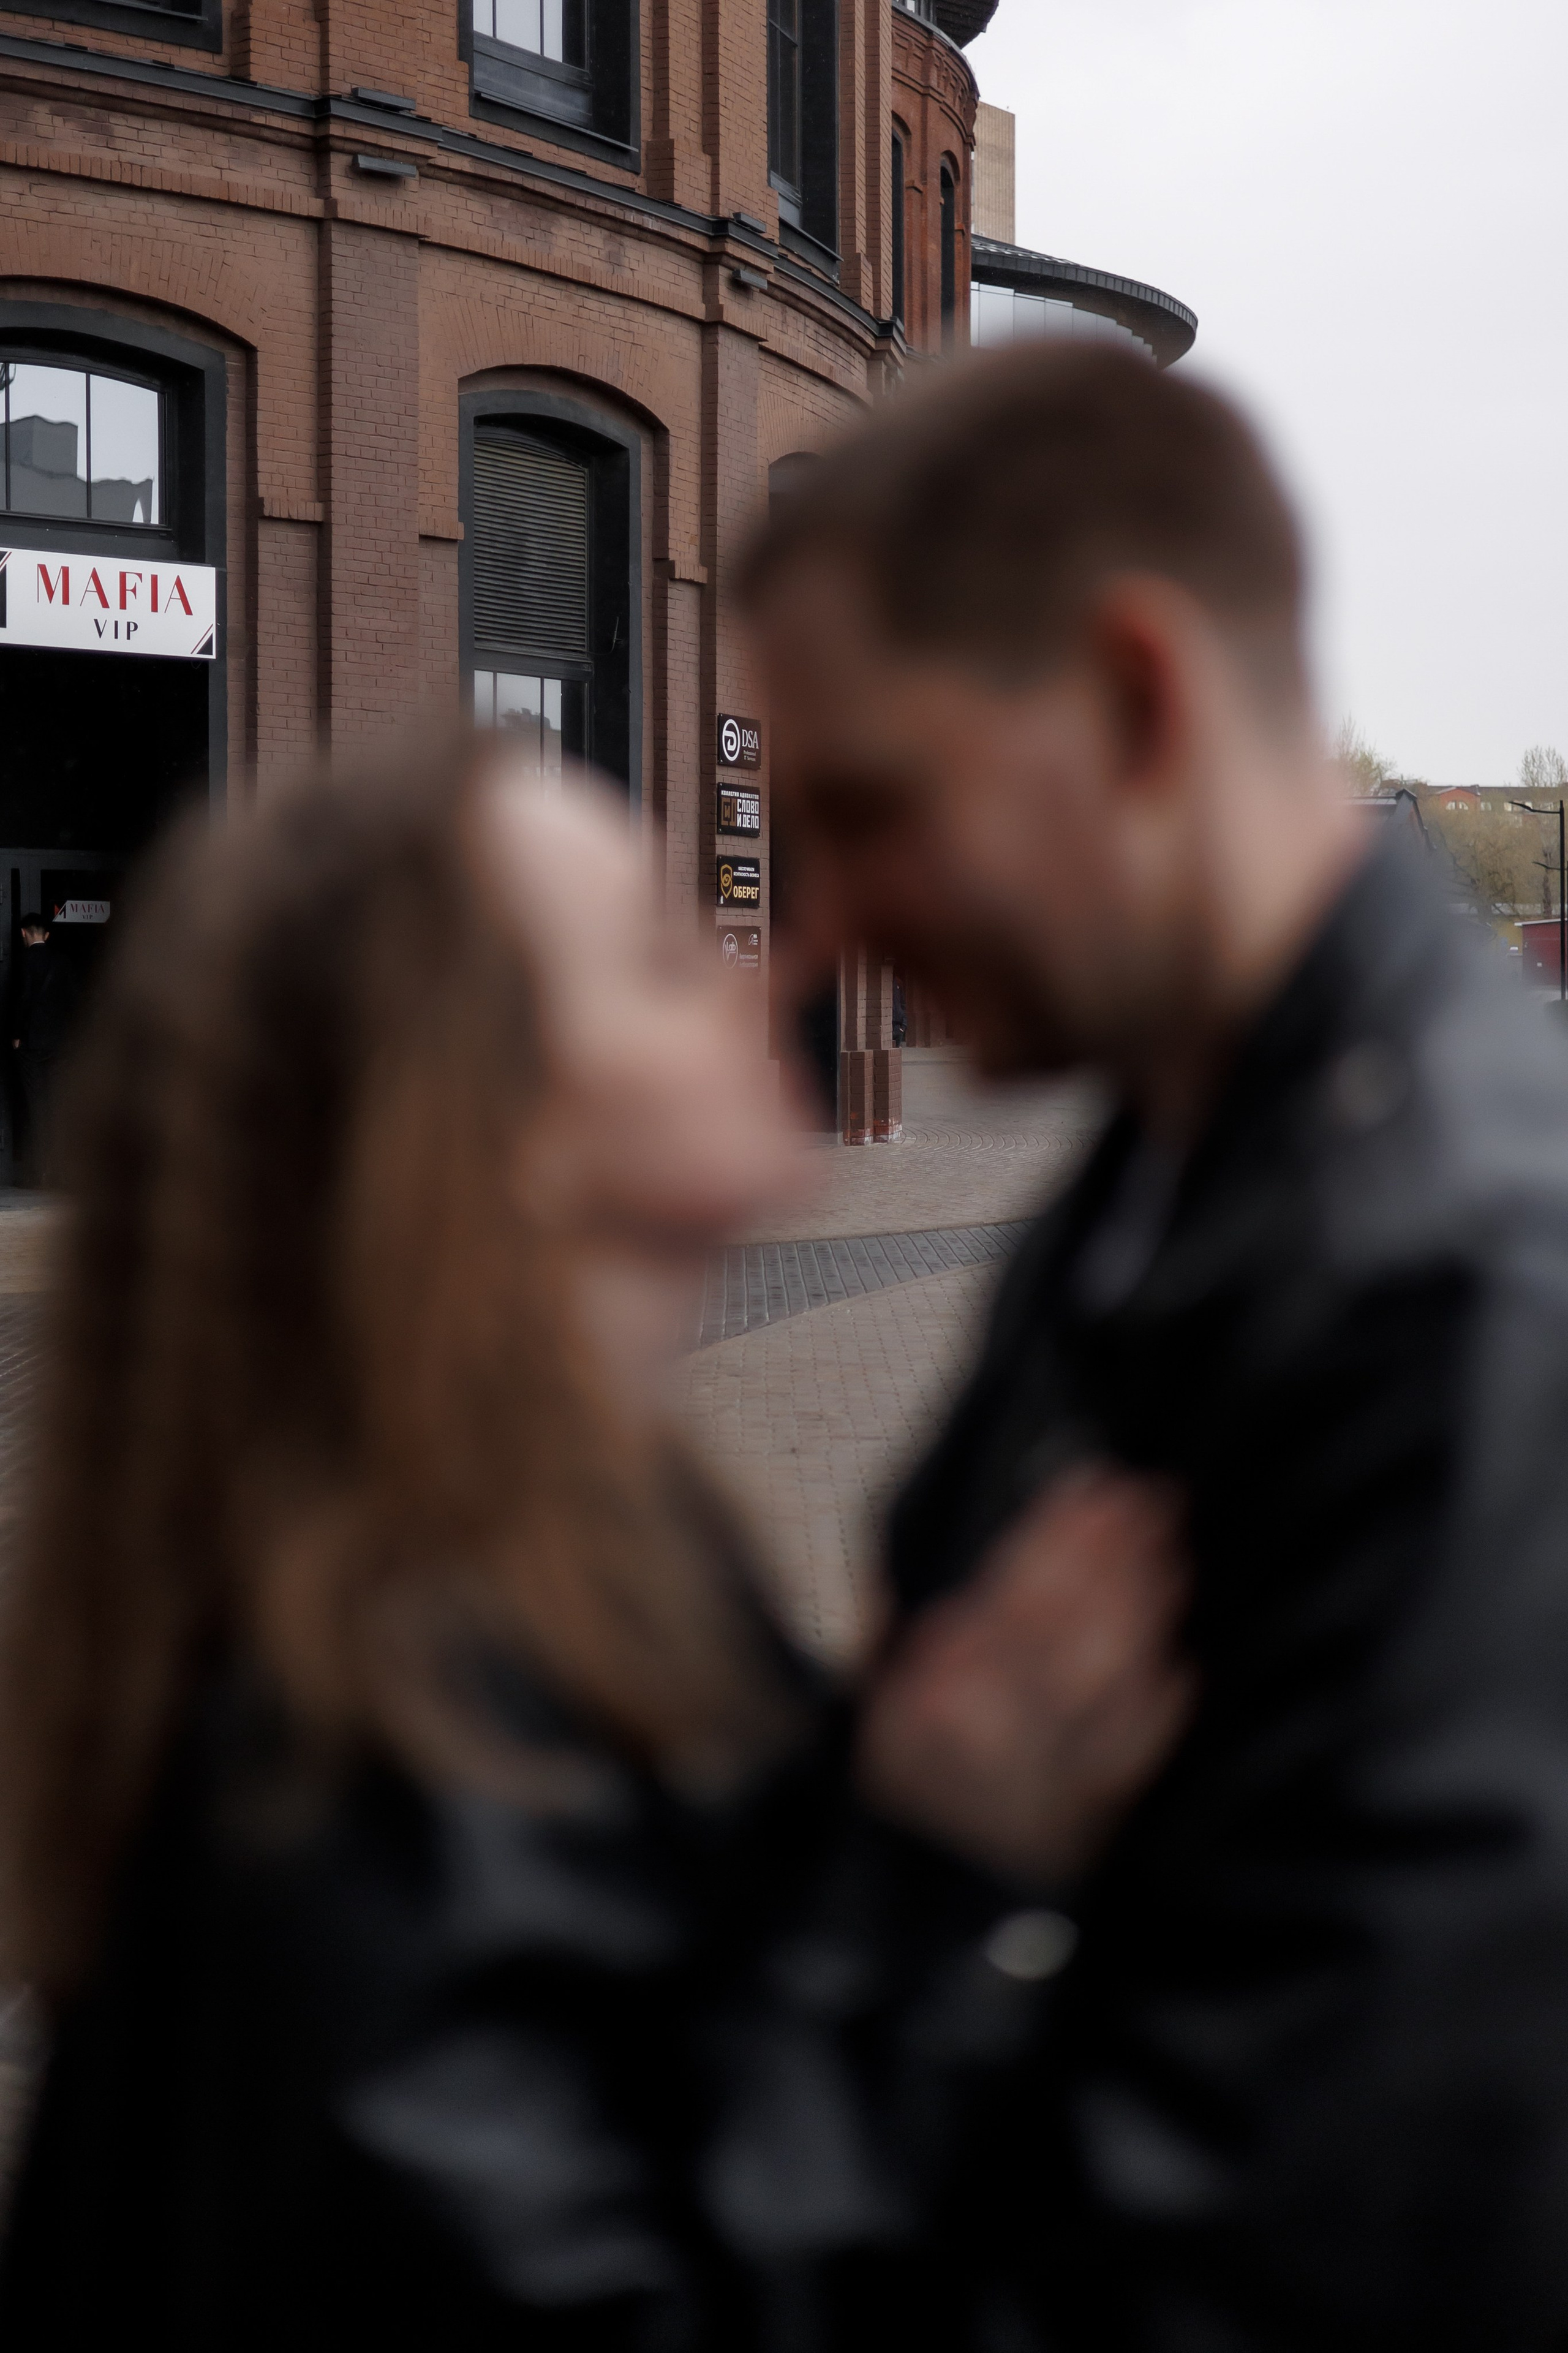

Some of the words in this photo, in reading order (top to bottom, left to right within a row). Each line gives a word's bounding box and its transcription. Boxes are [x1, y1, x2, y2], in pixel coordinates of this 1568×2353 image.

[37, 564, 193, 616] MAFIA
[94, 619, 138, 641] VIP
[742, 729, 759, 749] DSA
[737, 799, 759, 814] СЛОВО
[737, 814, 742, 827] И
[742, 814, 759, 829] ДЕЛО
[733, 886, 759, 899] ОБЕРЕГ
[70, 903, 105, 913] MAFIA
